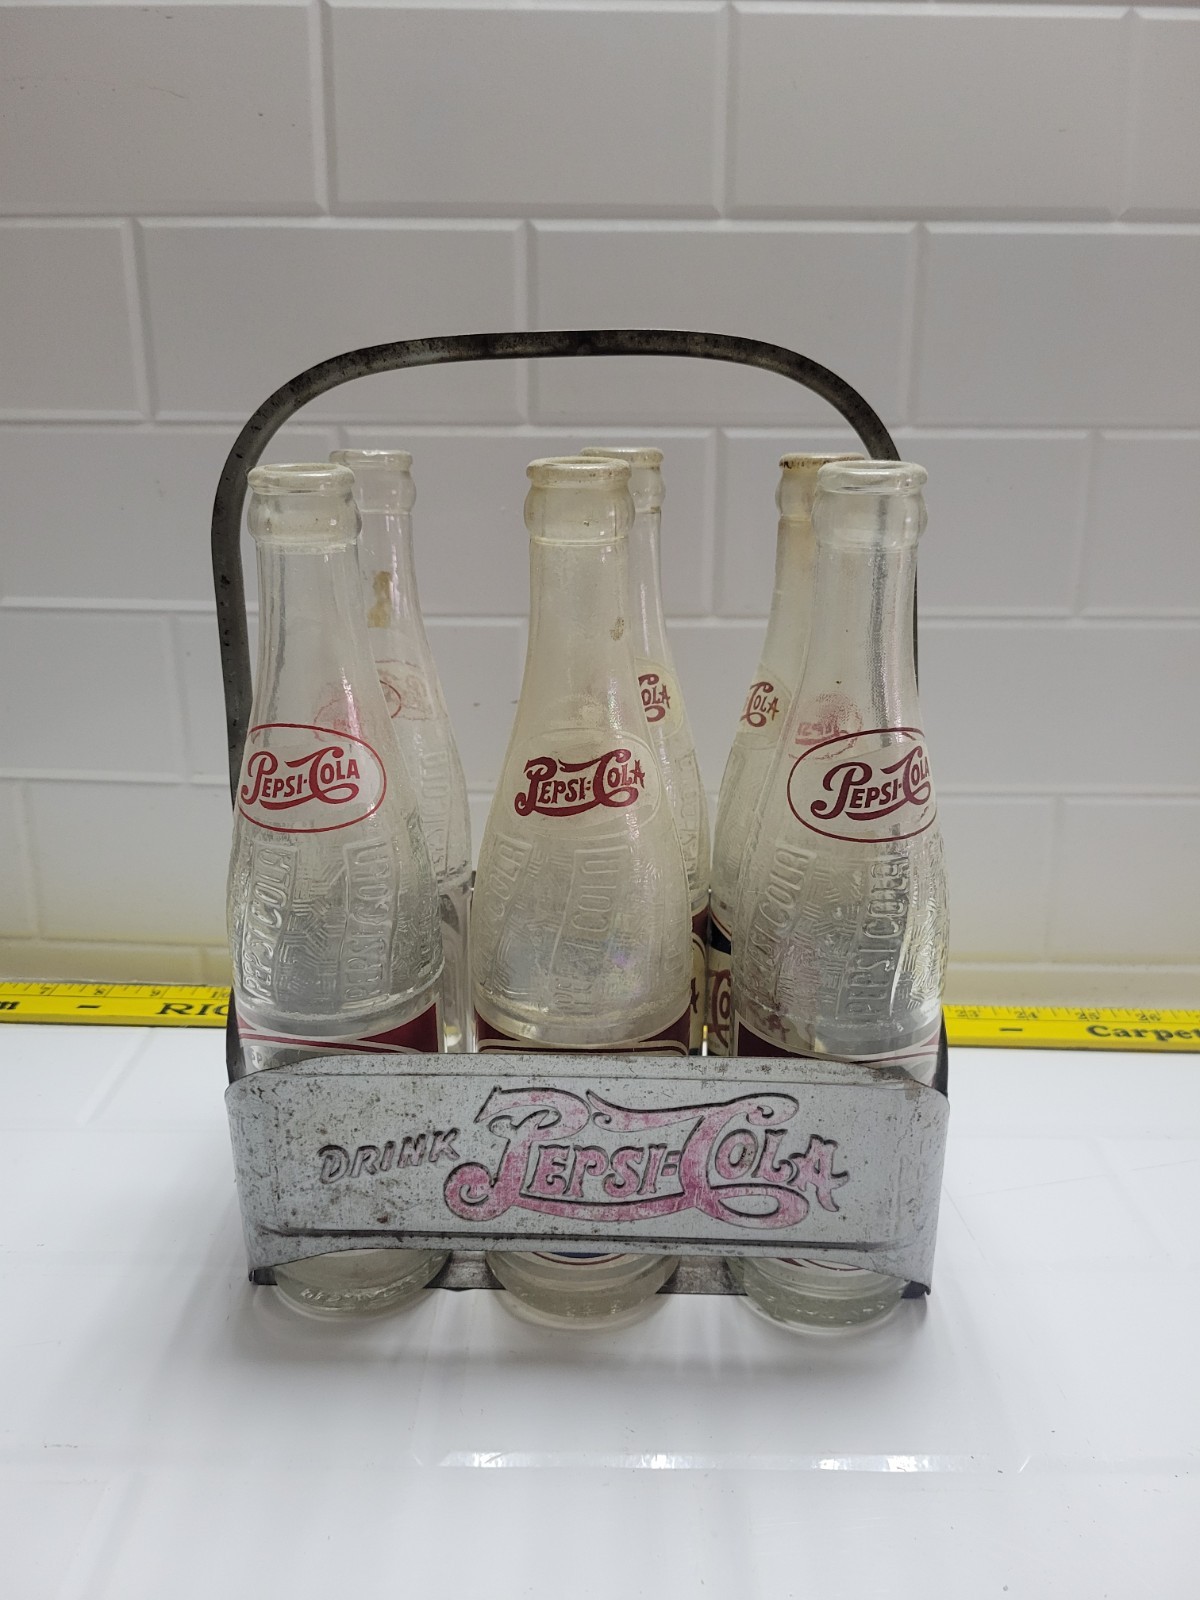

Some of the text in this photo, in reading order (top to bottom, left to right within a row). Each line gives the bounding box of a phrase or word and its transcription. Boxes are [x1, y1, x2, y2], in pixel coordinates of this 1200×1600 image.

[240, 746, 361, 811] PEPSI-COLA
[810, 745, 931, 821] PEPSI-COLA
[316, 1087, 850, 1230] DRINK PEPSI-COLA
